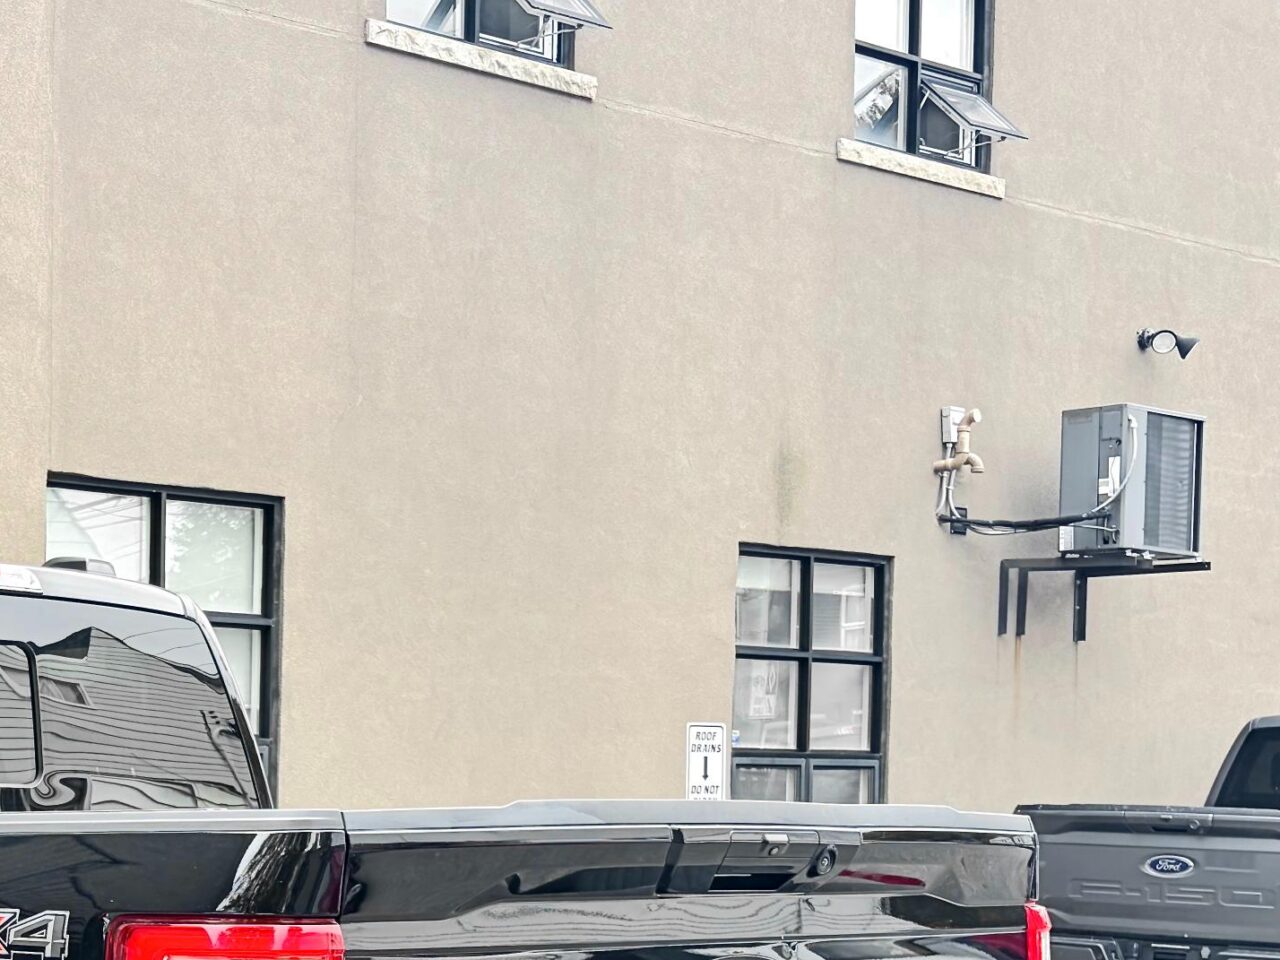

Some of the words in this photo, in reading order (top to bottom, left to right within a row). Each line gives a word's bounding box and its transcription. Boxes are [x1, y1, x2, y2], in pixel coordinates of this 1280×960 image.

[695, 731, 718, 741] ROOF
[691, 743, 722, 753] DRAINS
[691, 785, 702, 795] DO
[704, 785, 720, 795] NOT
[1155, 859, 1182, 872] Ford
